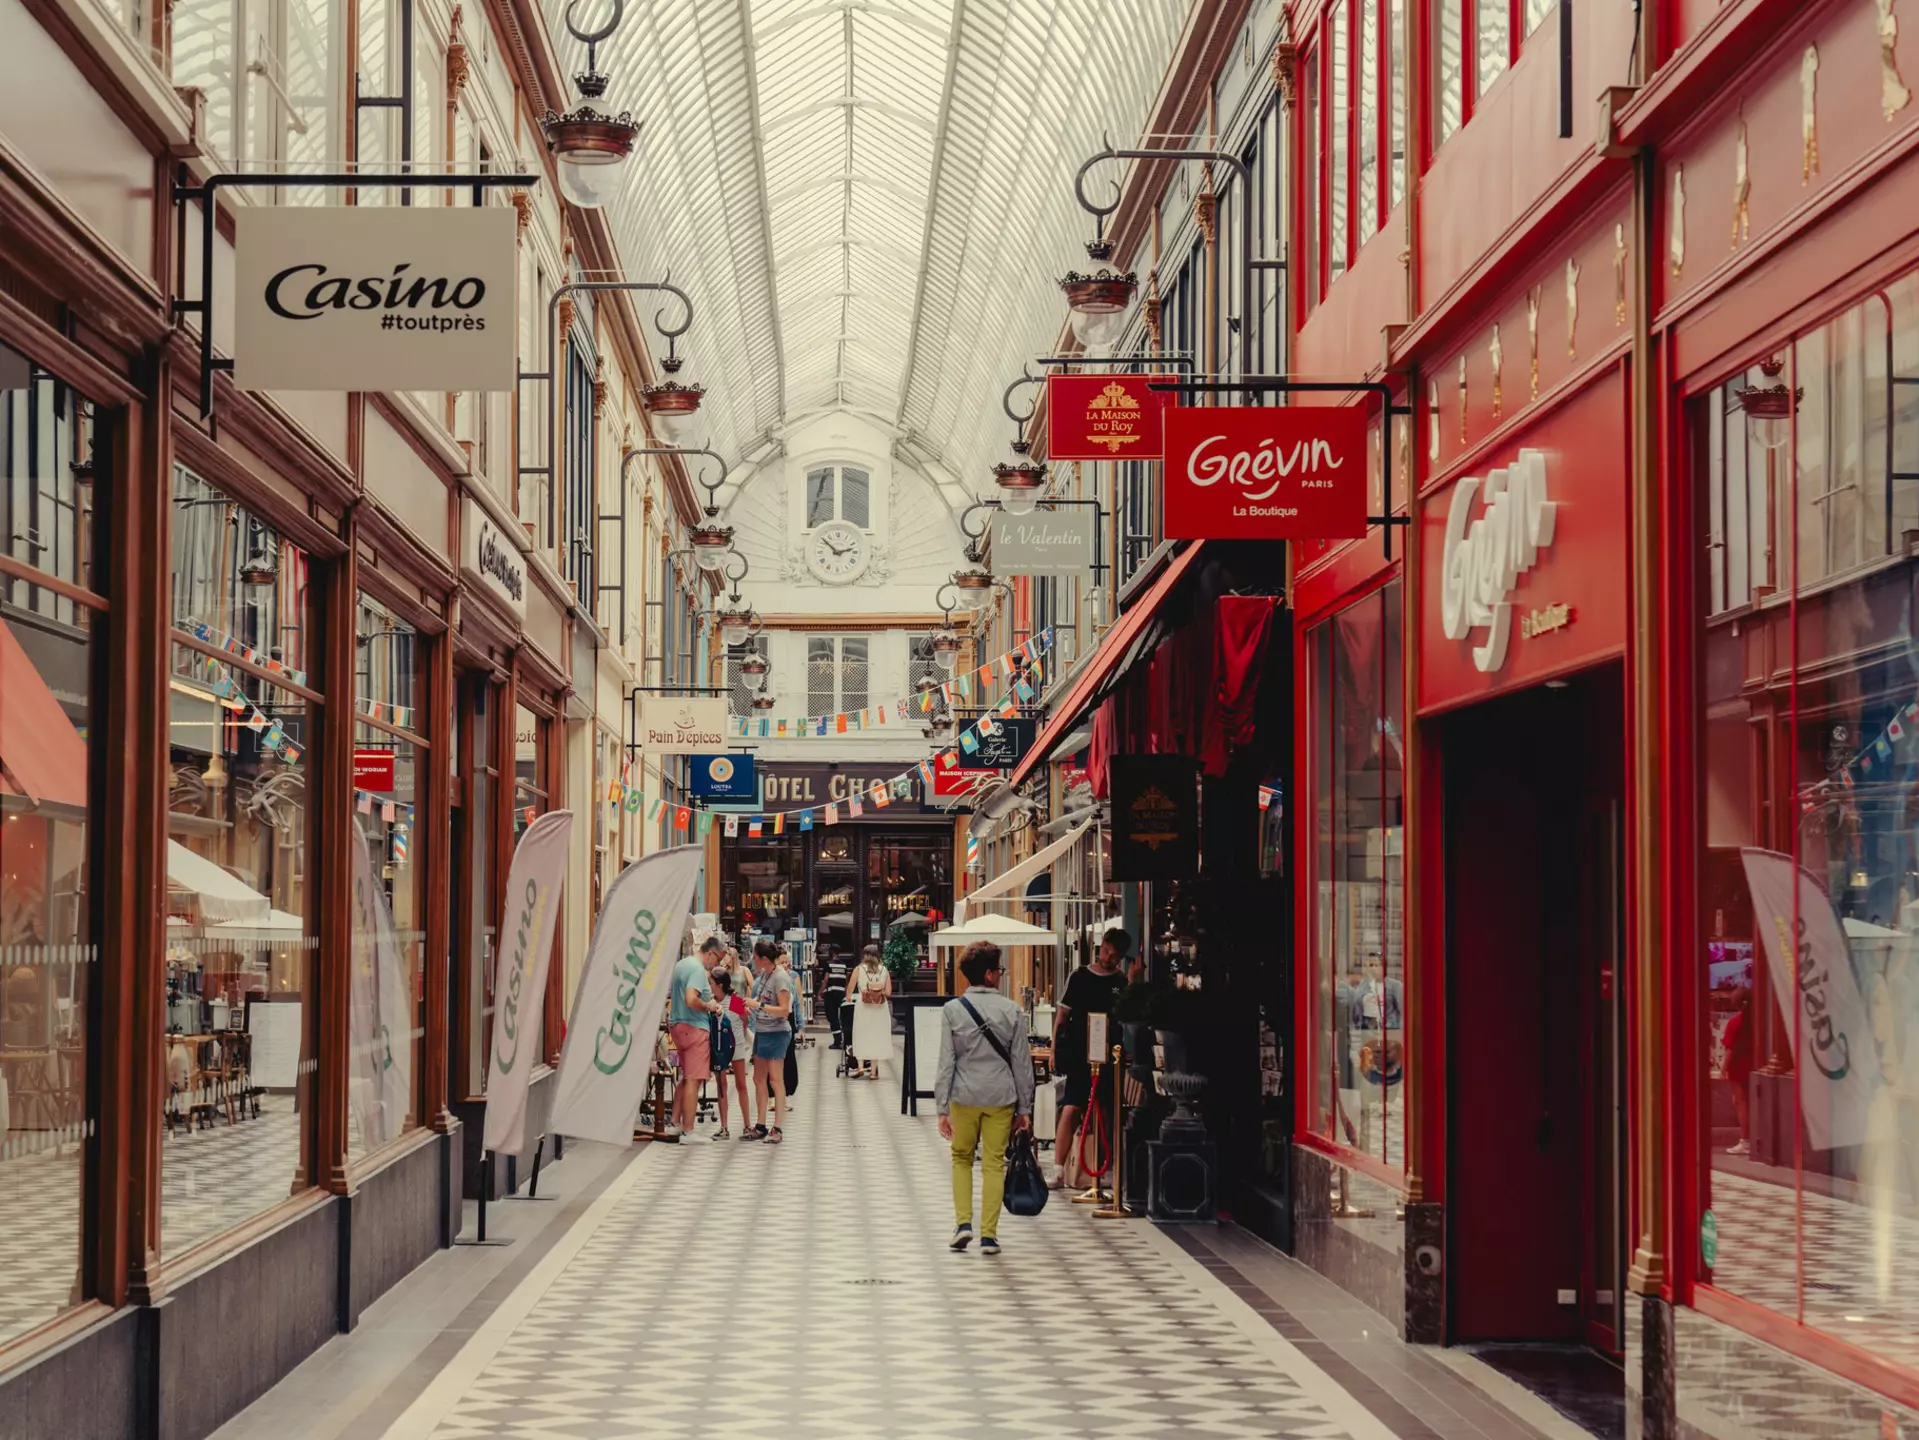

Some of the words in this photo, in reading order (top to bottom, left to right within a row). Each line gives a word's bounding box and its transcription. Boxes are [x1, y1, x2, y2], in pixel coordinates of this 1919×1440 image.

[264, 263, 486, 320] Casino
[381, 313, 486, 333] #toutprès
[1086, 411, 1098, 420] LA
[1301, 480, 1334, 488] PARIS
[1233, 506, 1247, 516] La
[1249, 506, 1298, 518] Boutique
[1000, 524, 1012, 545] le
[1017, 524, 1083, 545] Valentin
[649, 730, 674, 744] Pain
[765, 773, 815, 801] ÔTEL
[828, 773, 920, 801] CHOI
[742, 893, 787, 909] HOTEL
[822, 893, 851, 905] HOTEL
[888, 894, 932, 911] HOTEL
[497, 878, 537, 1075] Casino
[594, 909, 656, 1075] Casino
